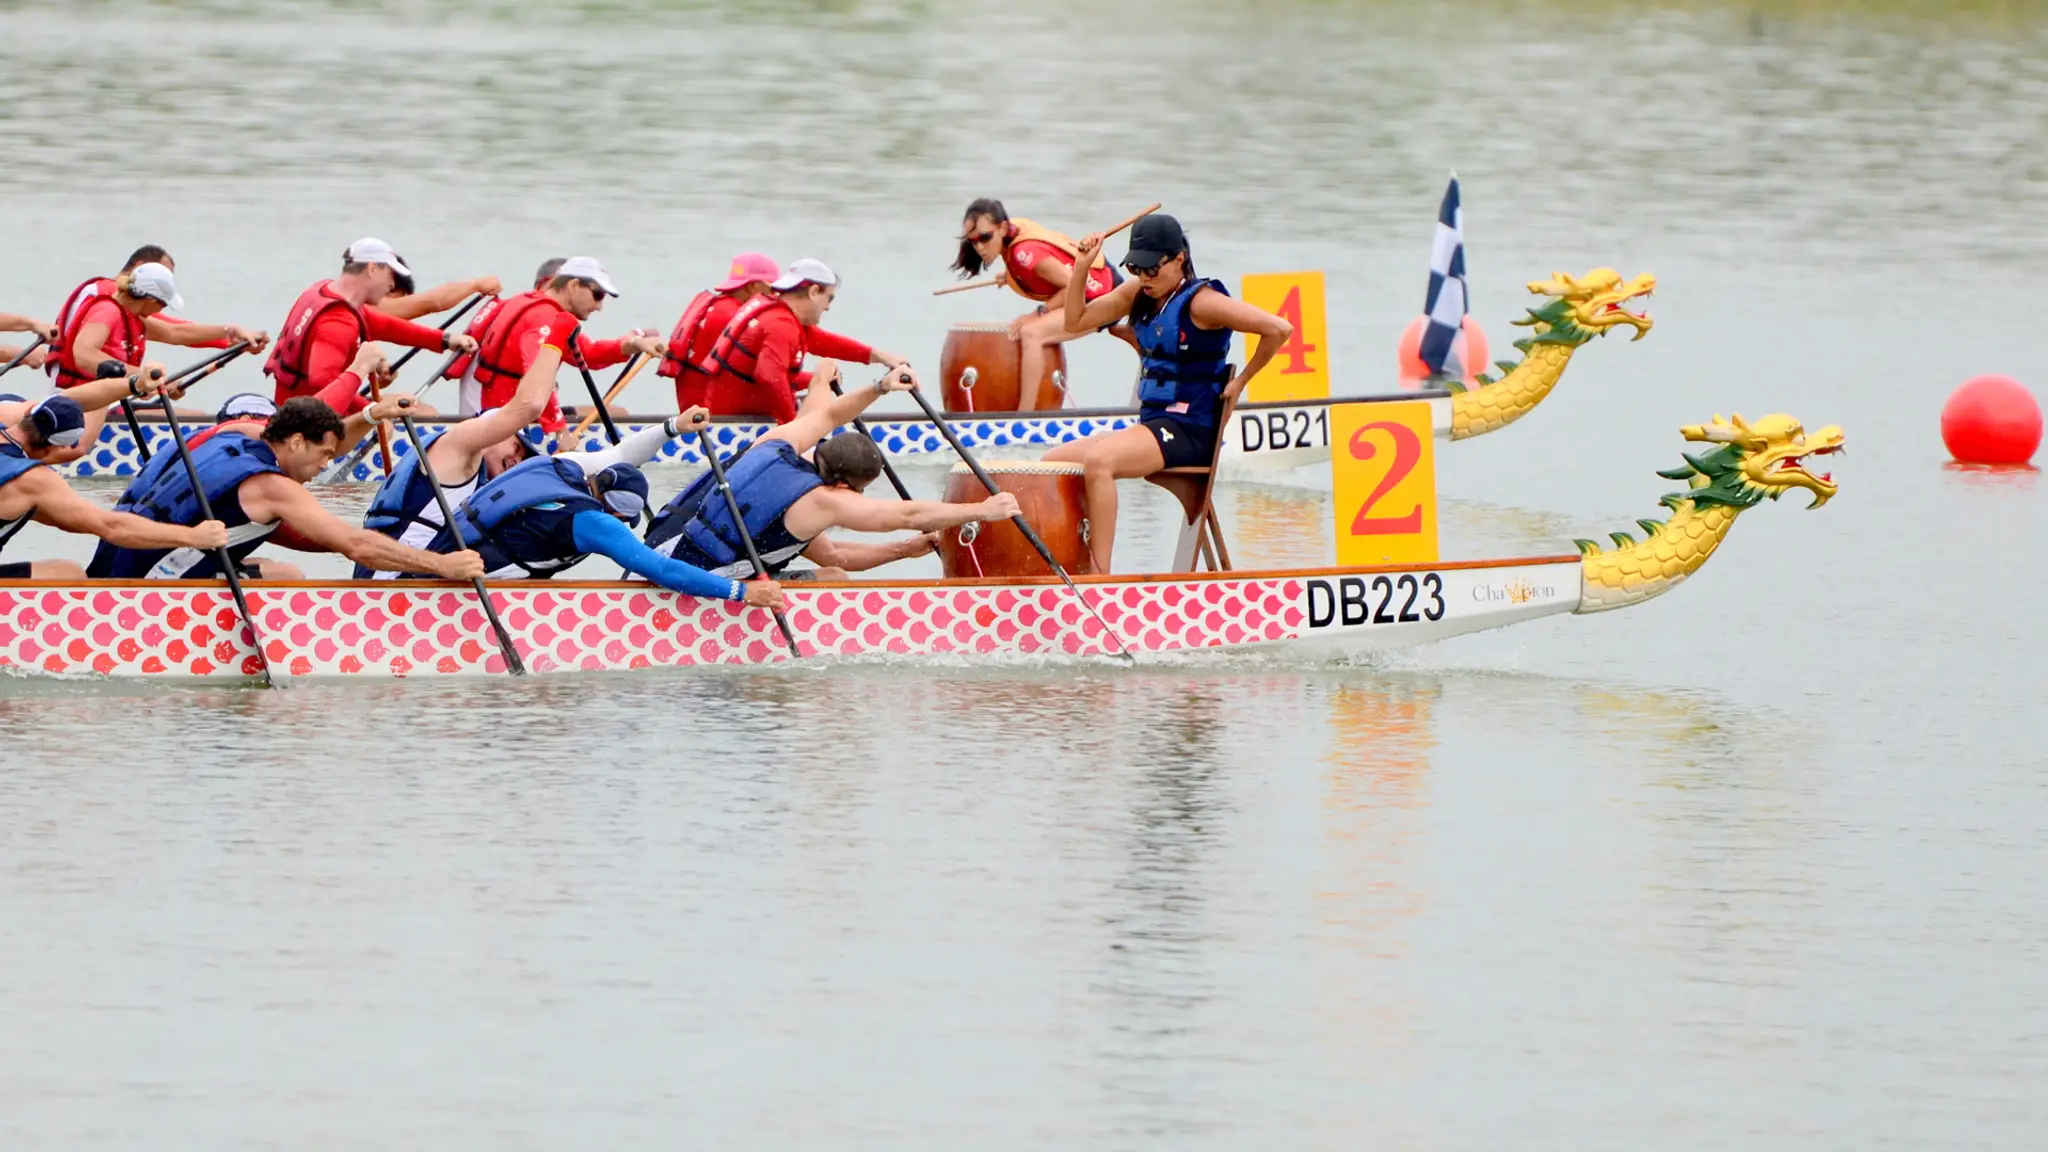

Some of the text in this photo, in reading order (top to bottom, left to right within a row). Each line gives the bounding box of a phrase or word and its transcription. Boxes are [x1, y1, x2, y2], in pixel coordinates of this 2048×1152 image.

[1275, 286, 1316, 374] 4
[1348, 421, 1422, 536] 2
[1307, 572, 1445, 628] DB223
